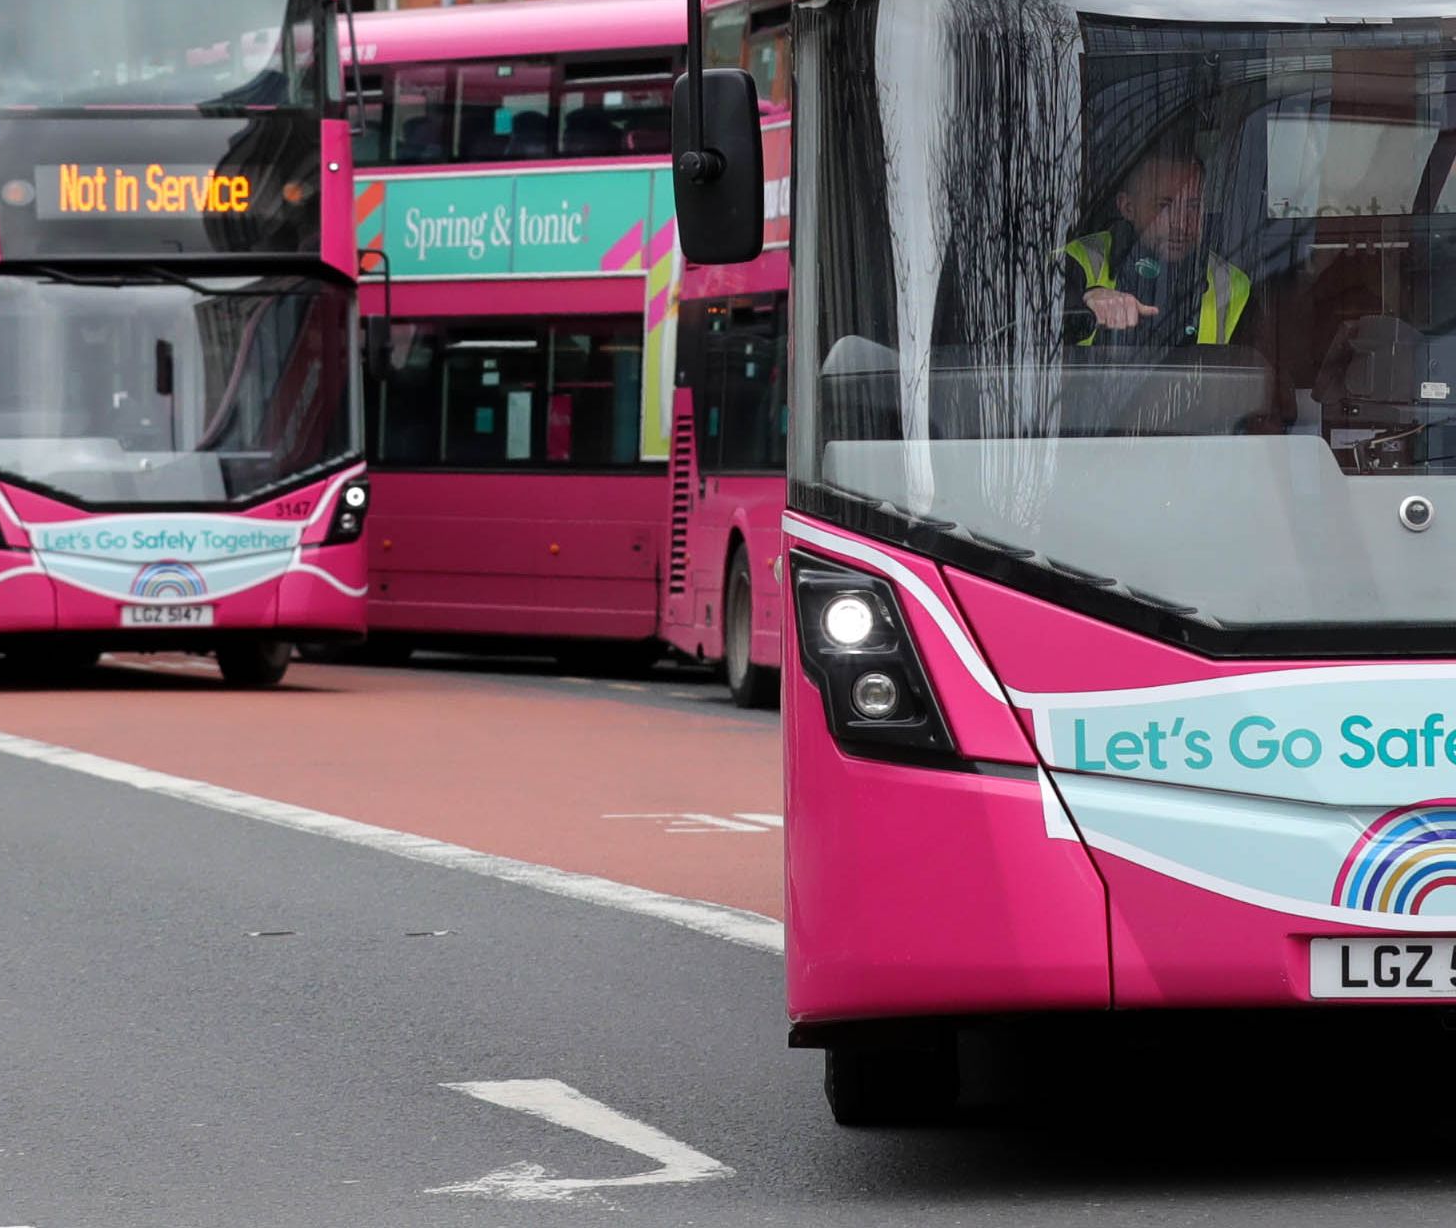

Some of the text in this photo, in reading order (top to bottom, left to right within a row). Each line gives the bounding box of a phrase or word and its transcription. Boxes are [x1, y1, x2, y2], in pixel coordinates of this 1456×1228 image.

[60, 164, 249, 212] Not in Service
[405, 200, 590, 260] Spring & tonic!
[275, 502, 311, 518] 3147
[44, 529, 290, 553] Let's Go Safely Together
[132, 606, 203, 623] LGZ 5147
[1074, 717, 1213, 770] Let's
[1229, 715, 1322, 770] Go
[1341, 945, 1433, 988] LGZ
